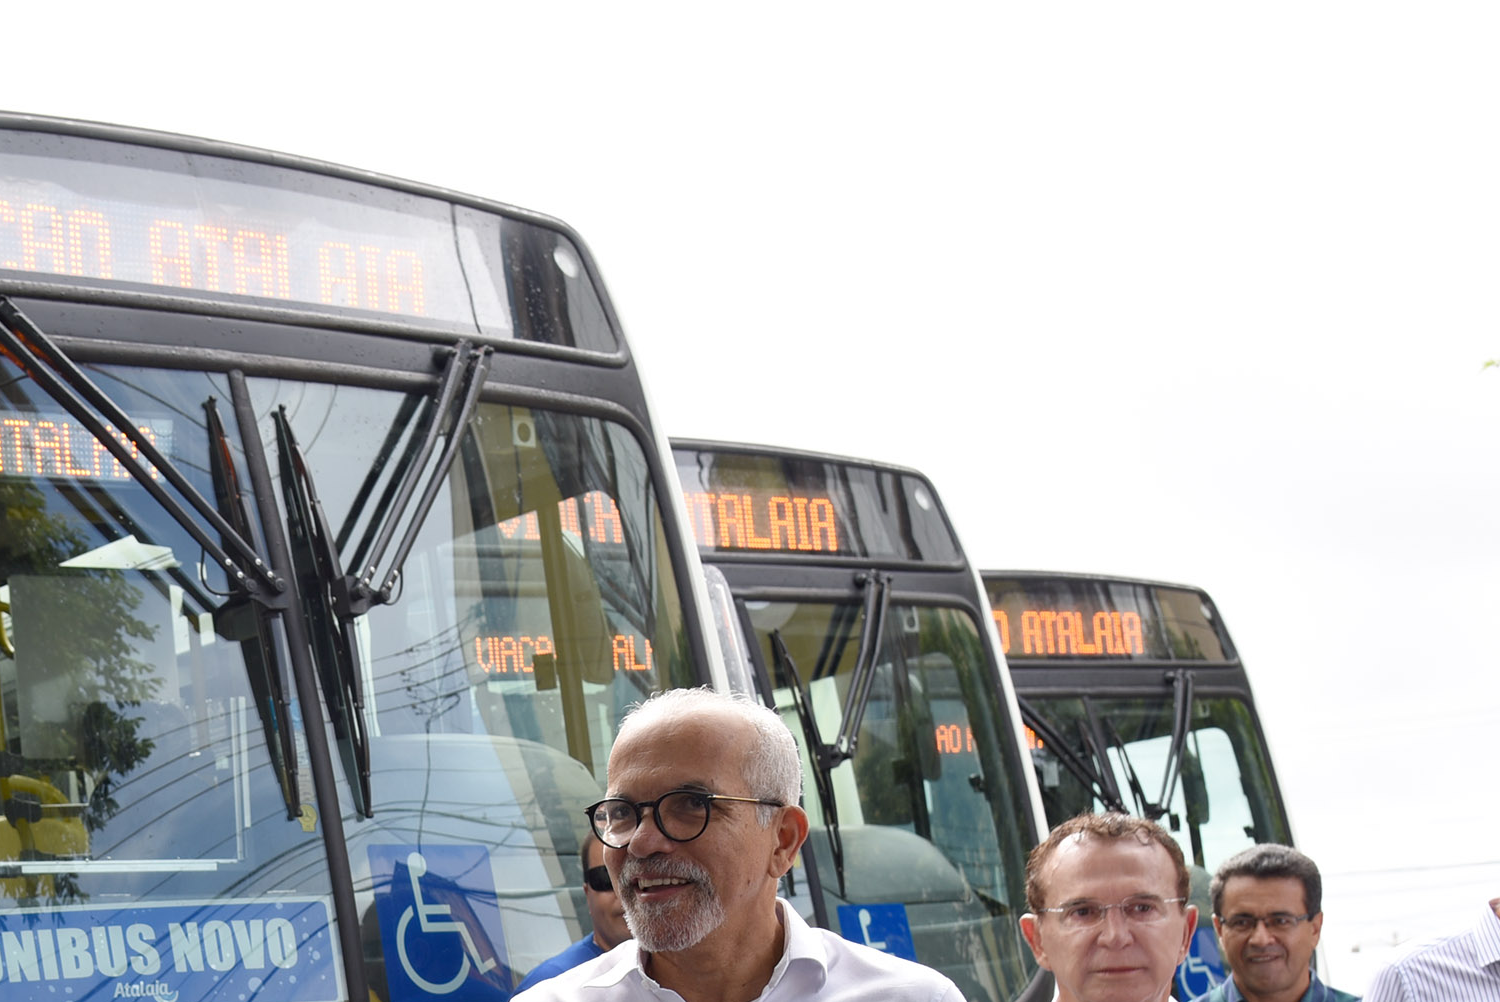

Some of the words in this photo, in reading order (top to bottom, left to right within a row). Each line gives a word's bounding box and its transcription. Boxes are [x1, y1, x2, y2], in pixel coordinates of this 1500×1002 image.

[1021, 610, 1144, 654] ATALAIA
[168, 917, 298, 973] NOVO
[113, 980, 173, 1000] Atalaia
